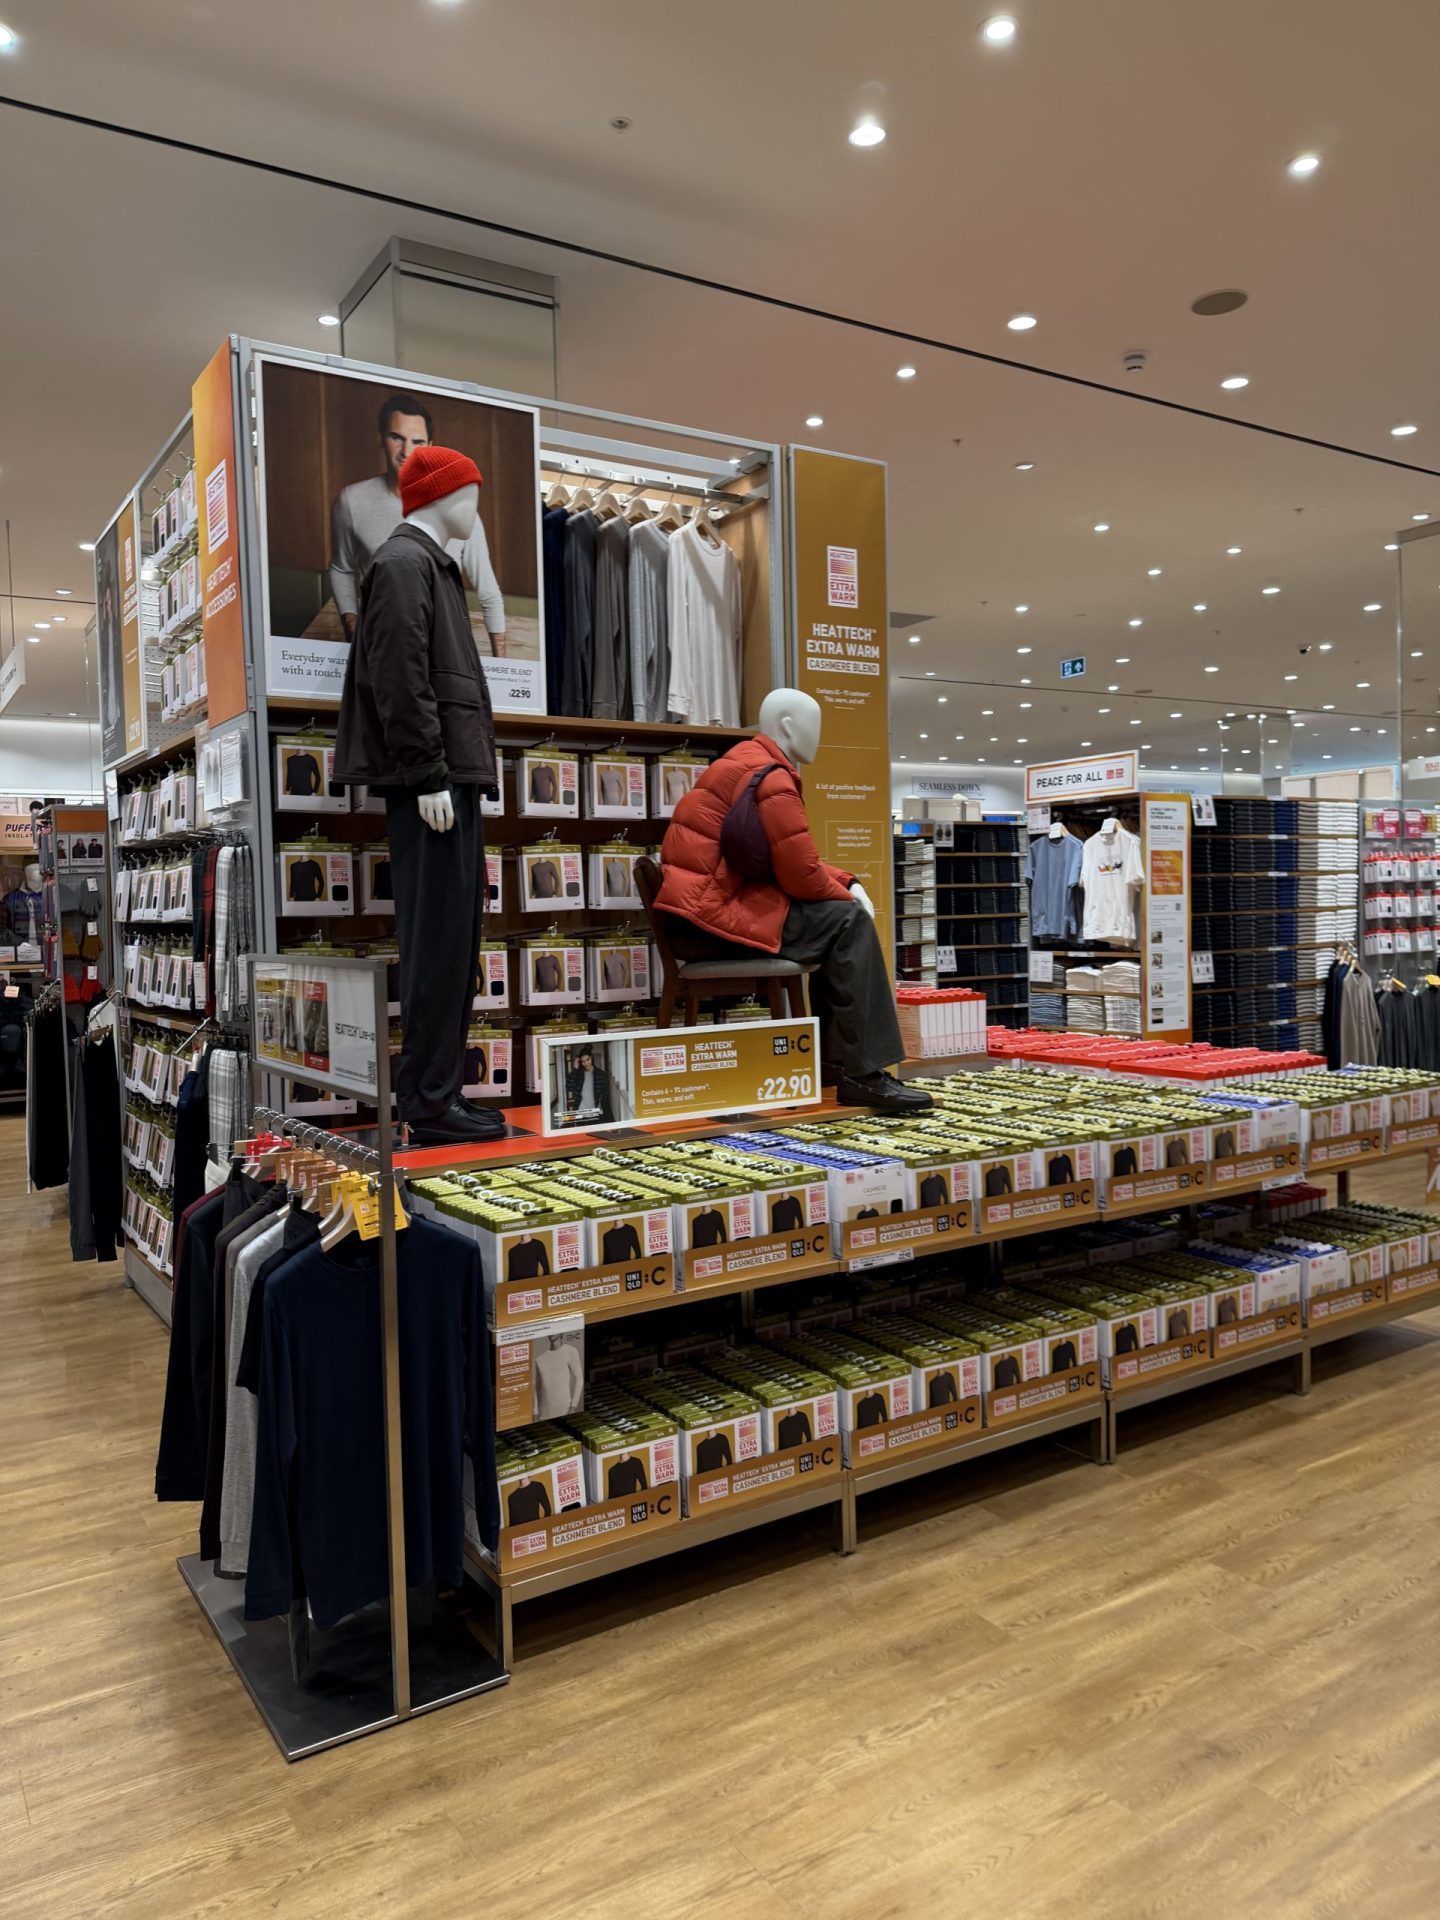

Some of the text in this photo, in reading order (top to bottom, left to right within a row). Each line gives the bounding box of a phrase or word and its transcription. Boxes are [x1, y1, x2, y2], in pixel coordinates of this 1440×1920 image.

[830, 552, 855, 560] HEATTECH
[831, 582, 855, 592] EXTRA
[831, 591, 855, 602] WARM
[807, 640, 880, 658] EXTRA WARM
[282, 650, 325, 665] Everyday
[282, 665, 304, 676] with
[314, 667, 341, 678] touch
[809, 660, 877, 674] CASHMERE BLEND
[1037, 777, 1063, 788] PEACE
[1066, 774, 1082, 784] FOR
[1086, 772, 1102, 781] ALL
[919, 783, 980, 791] SEAMLESS DOWN
[775, 1046, 788, 1054] QLO
[664, 1052, 684, 1060] EXTRA
[691, 1050, 737, 1061] EXTRA WARM
[665, 1059, 684, 1067] WARM
[693, 1063, 719, 1071] CASHMERE
[757, 1074, 811, 1101] £22.90
[597, 1206, 620, 1215] CASHMERE
[501, 1221, 529, 1229] CASHMERE
[734, 1219, 750, 1227] EXTRA
[734, 1226, 751, 1234] WARM
[649, 1235, 668, 1244] EXTRA
[558, 1249, 579, 1259] EXTRA
[559, 1256, 579, 1265] WARM
[728, 1252, 785, 1270] CASHMERE BLEND
[582, 1277, 600, 1287] EXTRA
[602, 1274, 620, 1282] WARM
[627, 1274, 640, 1282] UNI
[627, 1281, 641, 1290] QLO
[550, 1285, 618, 1305] CASHMERE BLEND
[818, 1418, 835, 1428] EXTRA
[818, 1424, 835, 1434] WARM
[601, 1440, 626, 1450] CASHMERE
[739, 1440, 757, 1449] EXTRA
[739, 1445, 758, 1455] WARM
[499, 1464, 526, 1477] CASHMERE
[655, 1463, 674, 1474] EXTRA
[655, 1470, 675, 1480] WARM
[735, 1468, 793, 1491] CASHMERE BLEND
[559, 1484, 580, 1495] EXTRA
[560, 1491, 580, 1503] WARM
[632, 1504, 646, 1514] UNI
[587, 1513, 606, 1525] EXTRA
[607, 1508, 625, 1519] WARM
[632, 1512, 647, 1522] QLO
[555, 1518, 623, 1545] CASHMERE BLEND
